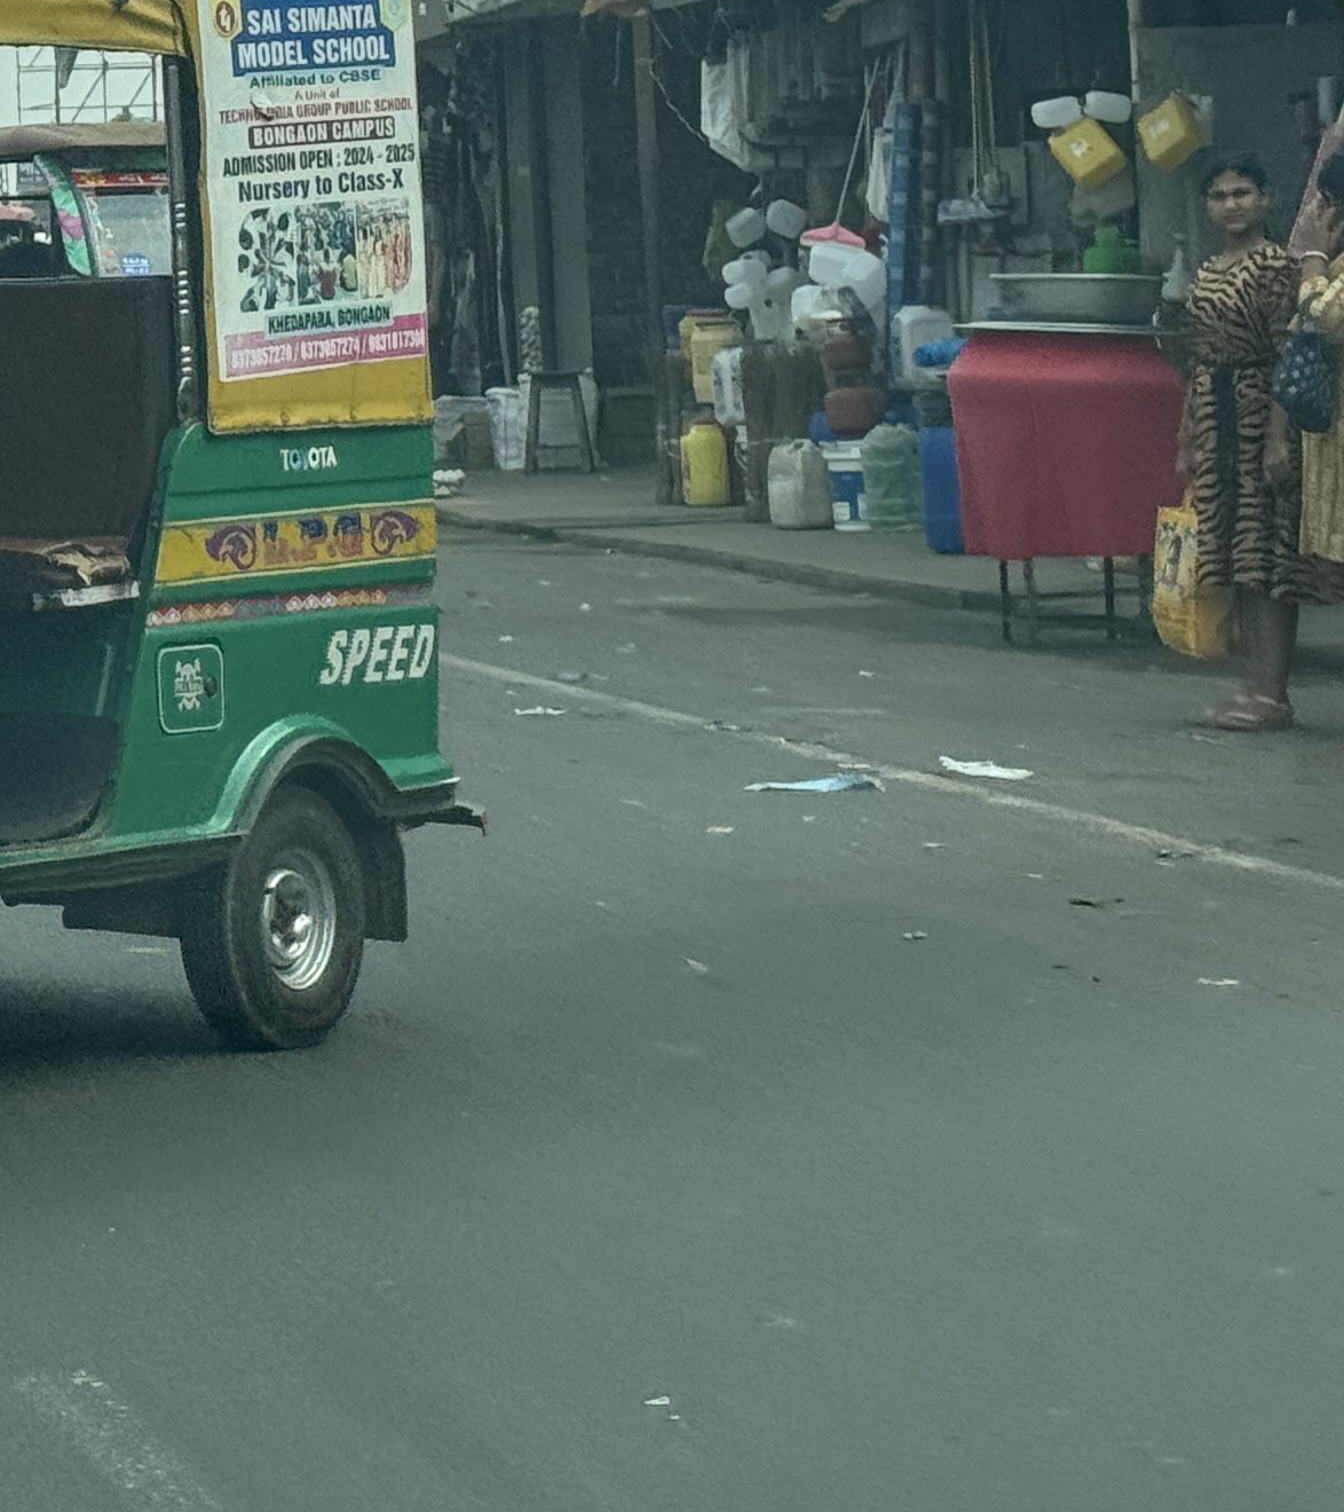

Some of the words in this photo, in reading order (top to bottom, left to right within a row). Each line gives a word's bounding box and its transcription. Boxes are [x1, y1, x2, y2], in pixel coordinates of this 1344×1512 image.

[247, 8, 281, 36] SAI
[287, 3, 377, 34] SIMANTA
[237, 41, 308, 70] MODEL
[313, 35, 390, 64] SCHOOL
[249, 71, 316, 88] Affiliated
[321, 72, 334, 85] to
[339, 68, 382, 82] CBSE
[252, 125, 328, 147] BONGAON
[331, 118, 394, 141] CAMPUS
[223, 153, 296, 177] ADMISSION
[299, 149, 333, 171] OPEN
[344, 145, 374, 165] 2024
[385, 143, 415, 164] 2025
[238, 180, 310, 203] Nursery
[315, 176, 332, 195] to
[338, 168, 405, 194] Class-X
[279, 445, 339, 472] TOYOTA
[318, 624, 435, 686] SPEED
